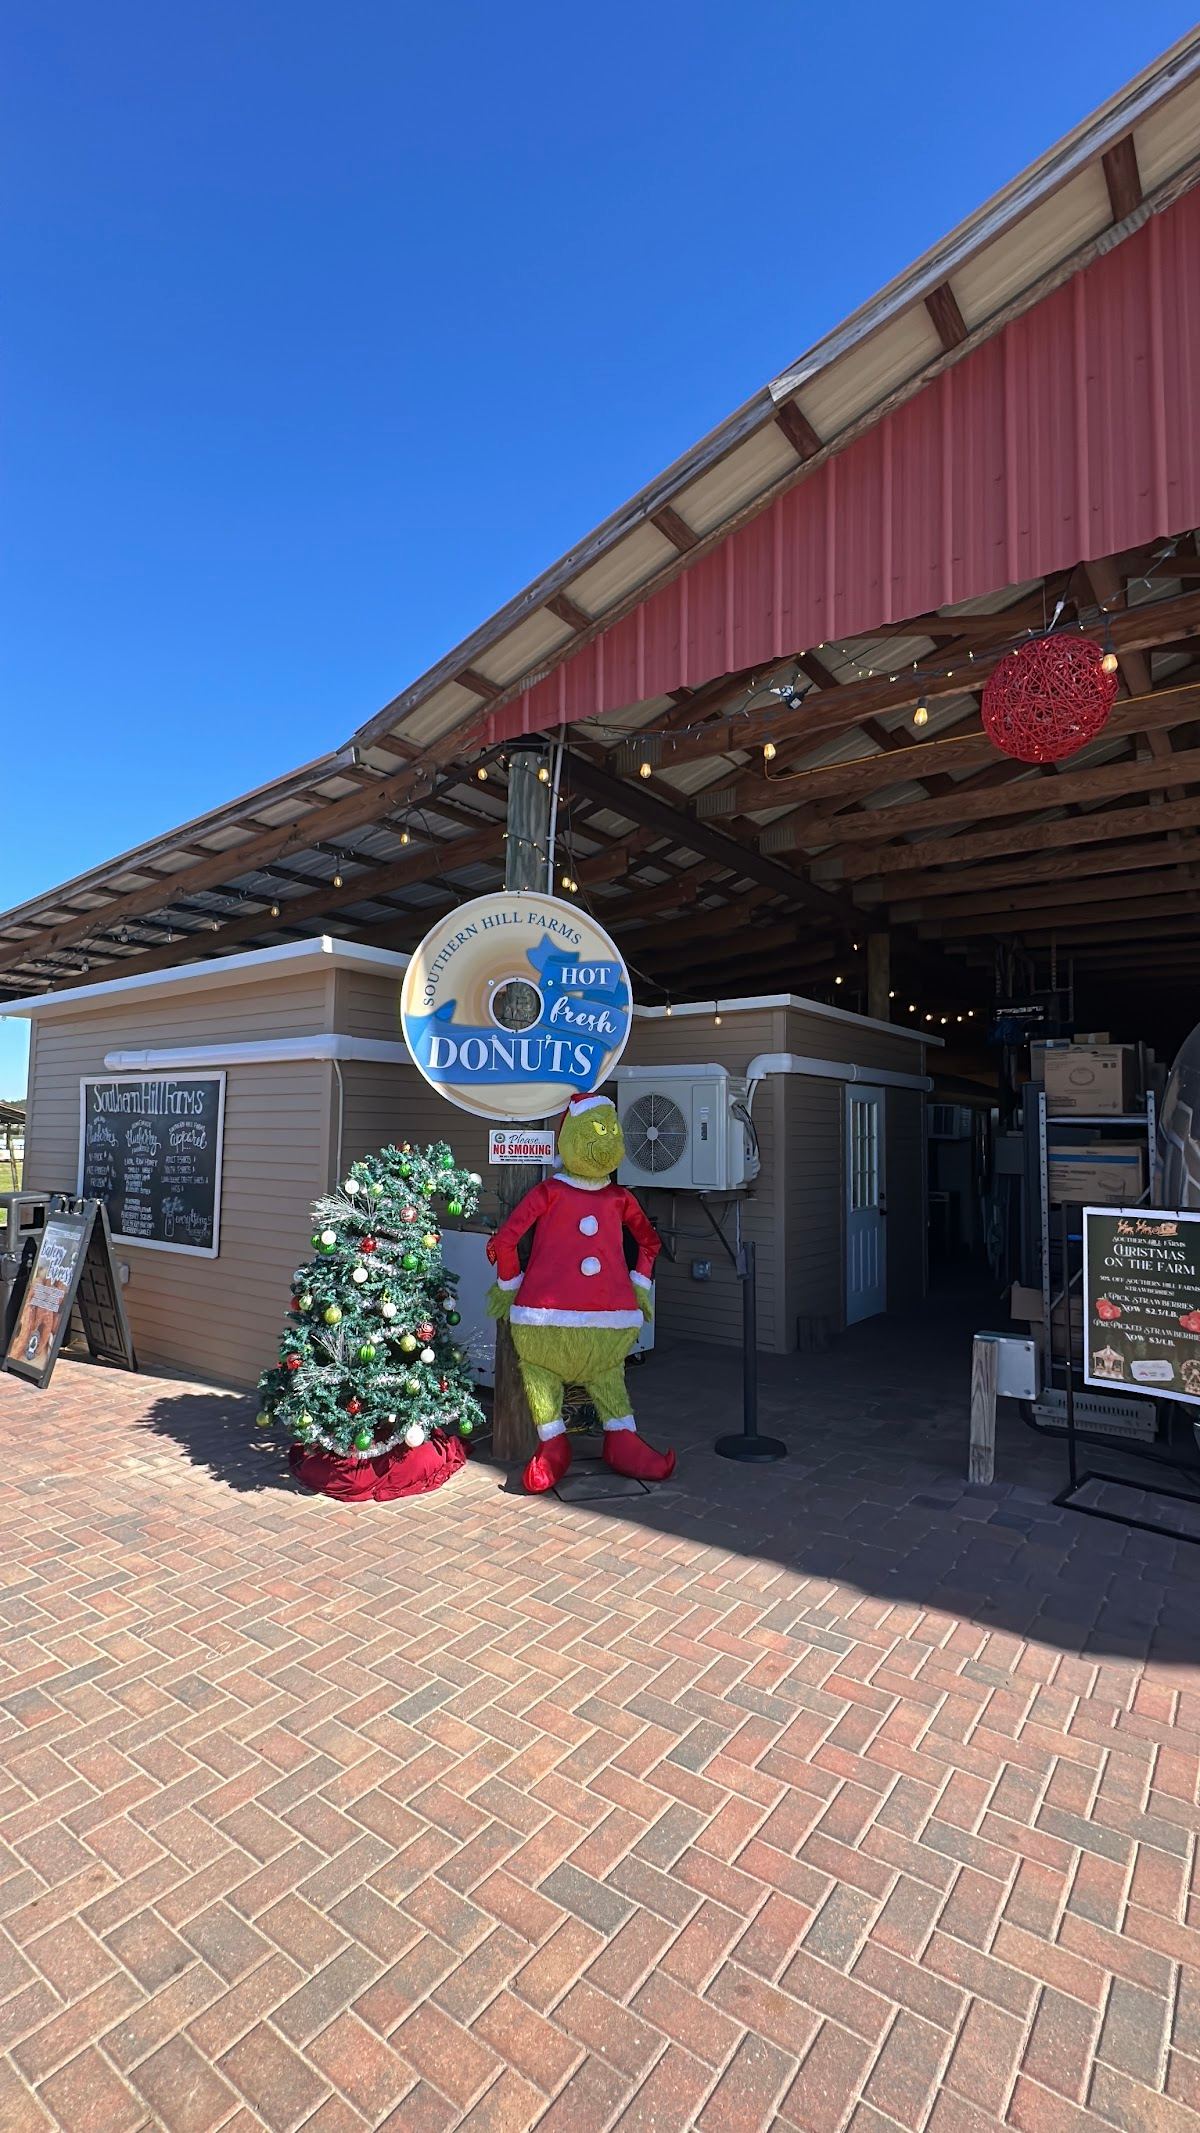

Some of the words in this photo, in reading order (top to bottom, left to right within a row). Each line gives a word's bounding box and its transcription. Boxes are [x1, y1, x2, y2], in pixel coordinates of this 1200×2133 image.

[424, 923, 479, 1006] SOUTHERN
[481, 912, 523, 930] HILL
[528, 912, 582, 945] FARMS
[561, 967, 611, 985] HOT
[550, 996, 616, 1034] fresh
[426, 1036, 594, 1076] DONUTS
[141, 1081, 166, 1115] Hill
[493, 1144, 506, 1155] NO
[508, 1144, 551, 1155] SMOKING
[1113, 1244, 1186, 1261] CHRISTMAS
[1104, 1257, 1123, 1267] ON
[1128, 1259, 1153, 1271] THE
[1157, 1262, 1196, 1276] FARM
[1121, 1303, 1141, 1313] NOW
[1132, 1296, 1194, 1310] STRAWBERRIES
[1125, 1332, 1145, 1343] NOW
